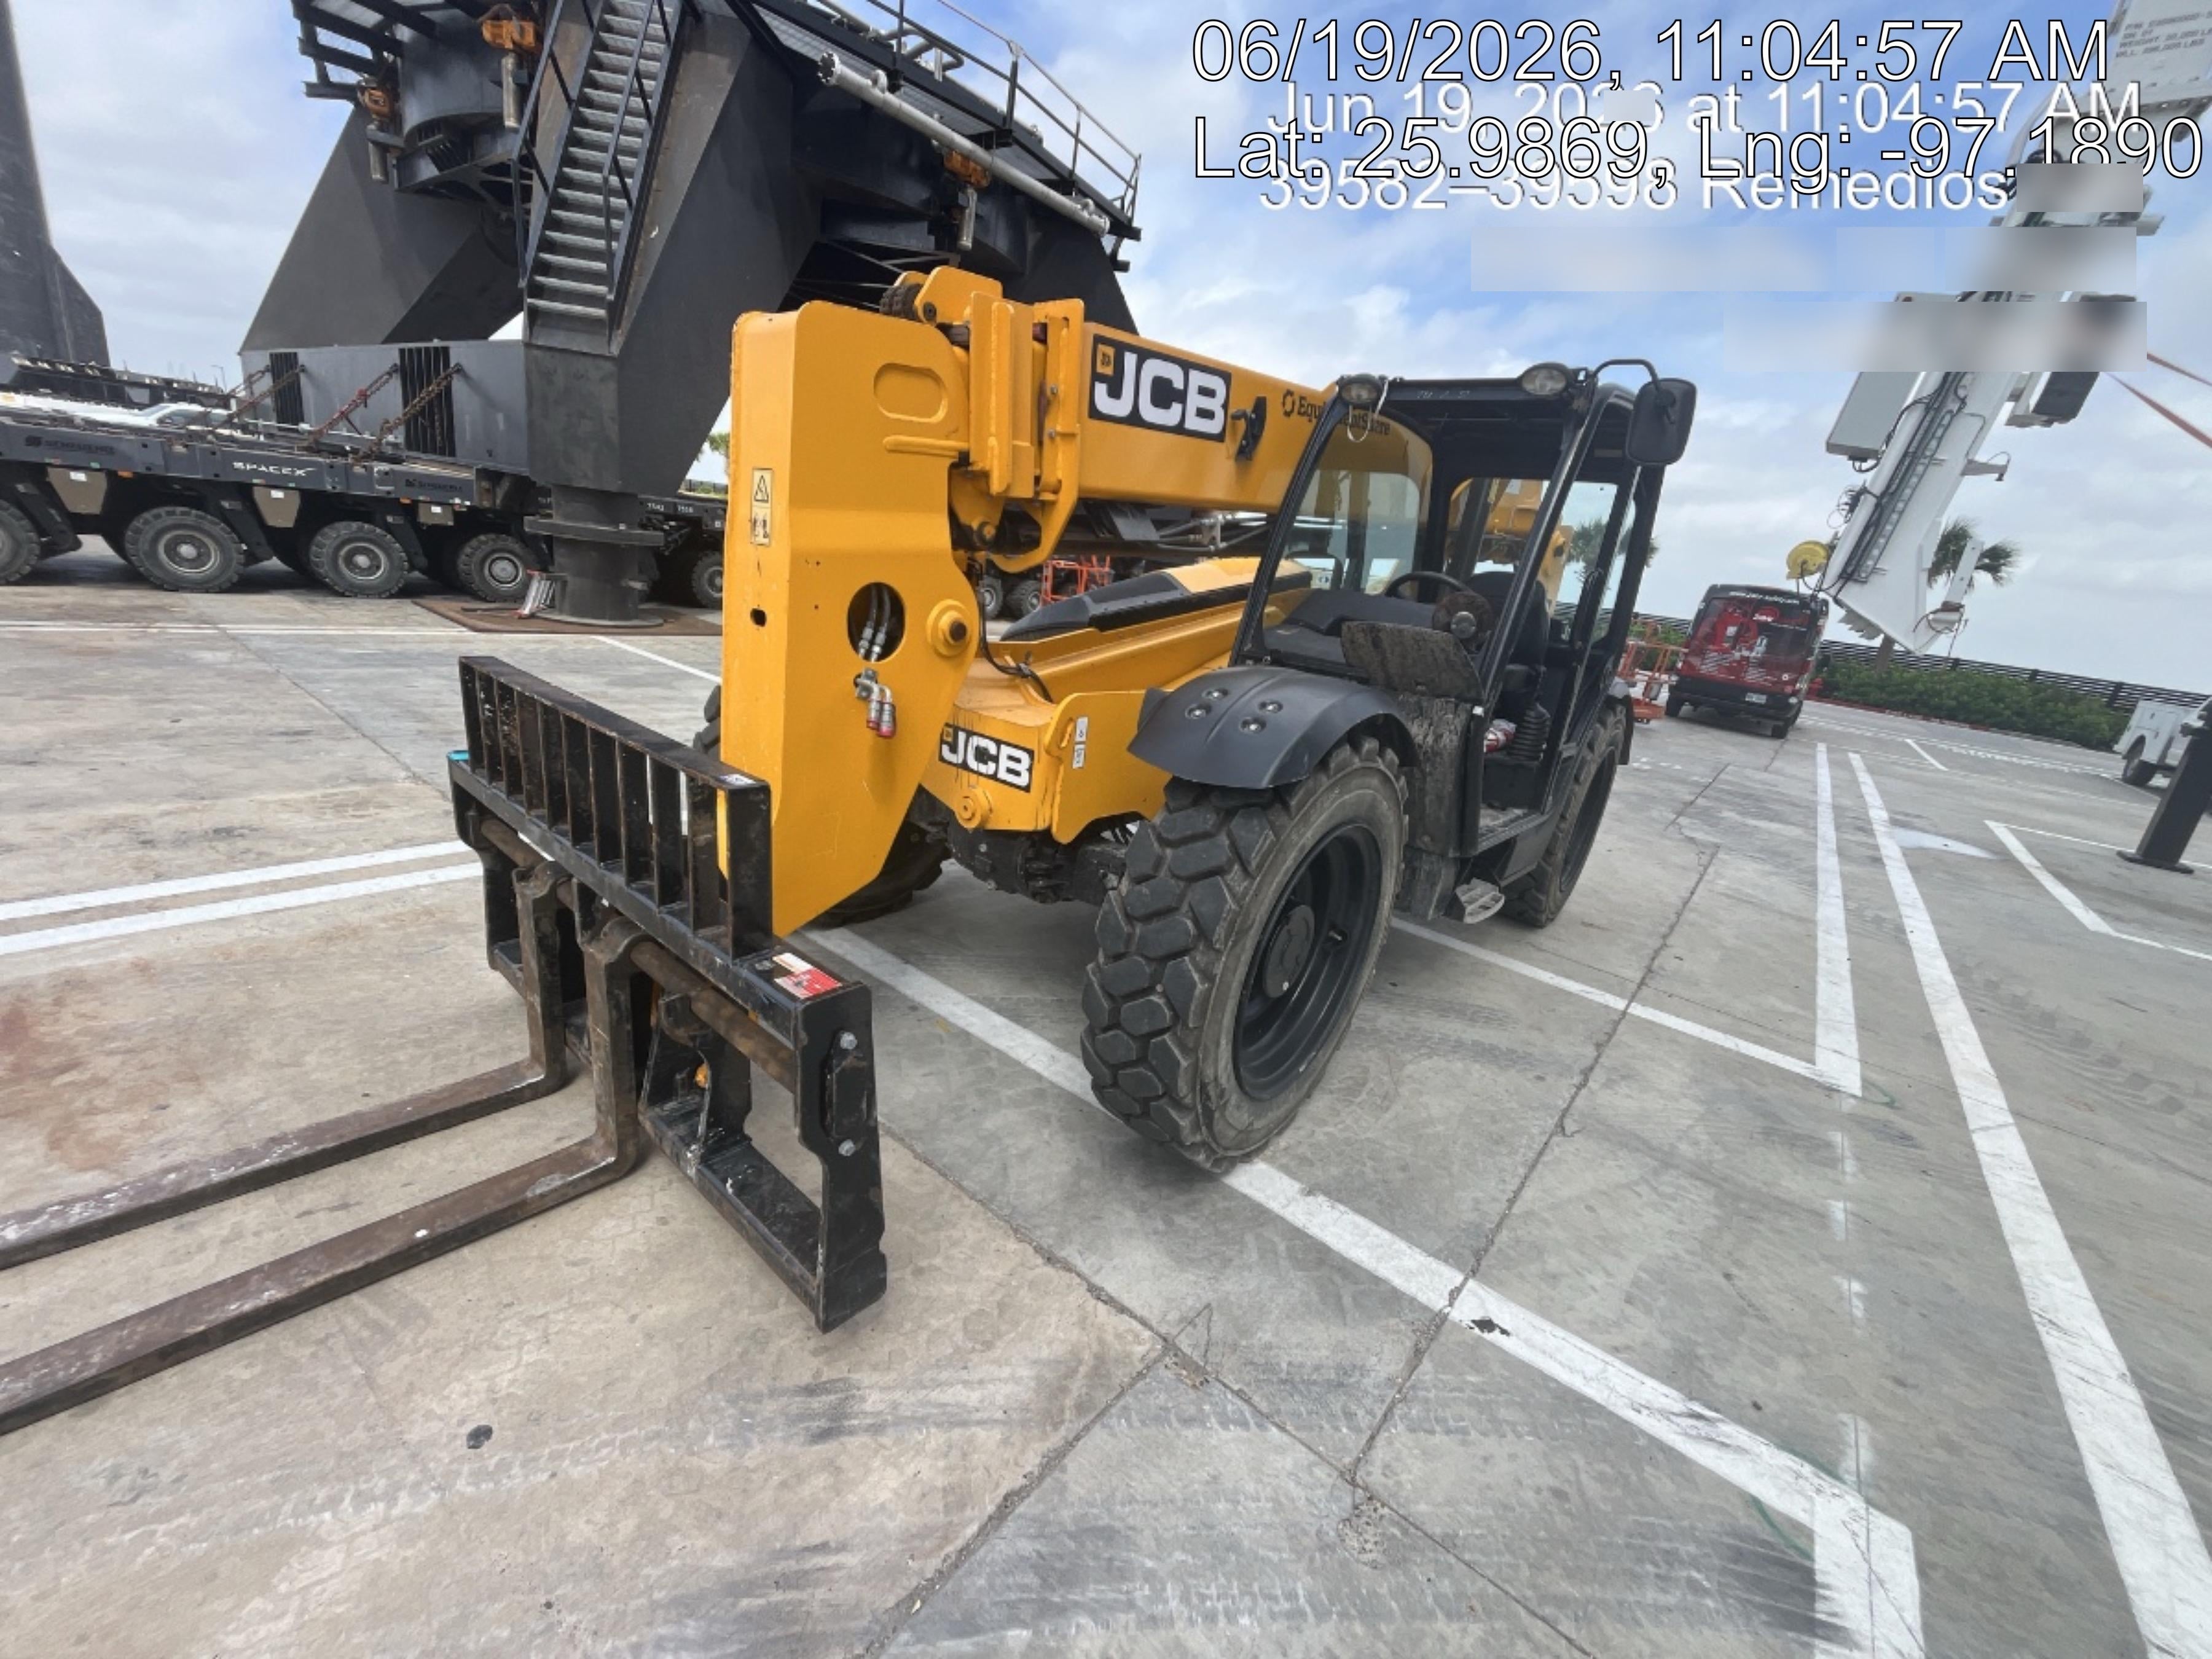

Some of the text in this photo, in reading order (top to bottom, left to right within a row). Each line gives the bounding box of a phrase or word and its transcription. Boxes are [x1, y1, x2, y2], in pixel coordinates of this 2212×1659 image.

[1094, 351, 1226, 434] JCB
[232, 461, 316, 476] SPACEX
[941, 731, 1031, 786] JCB
